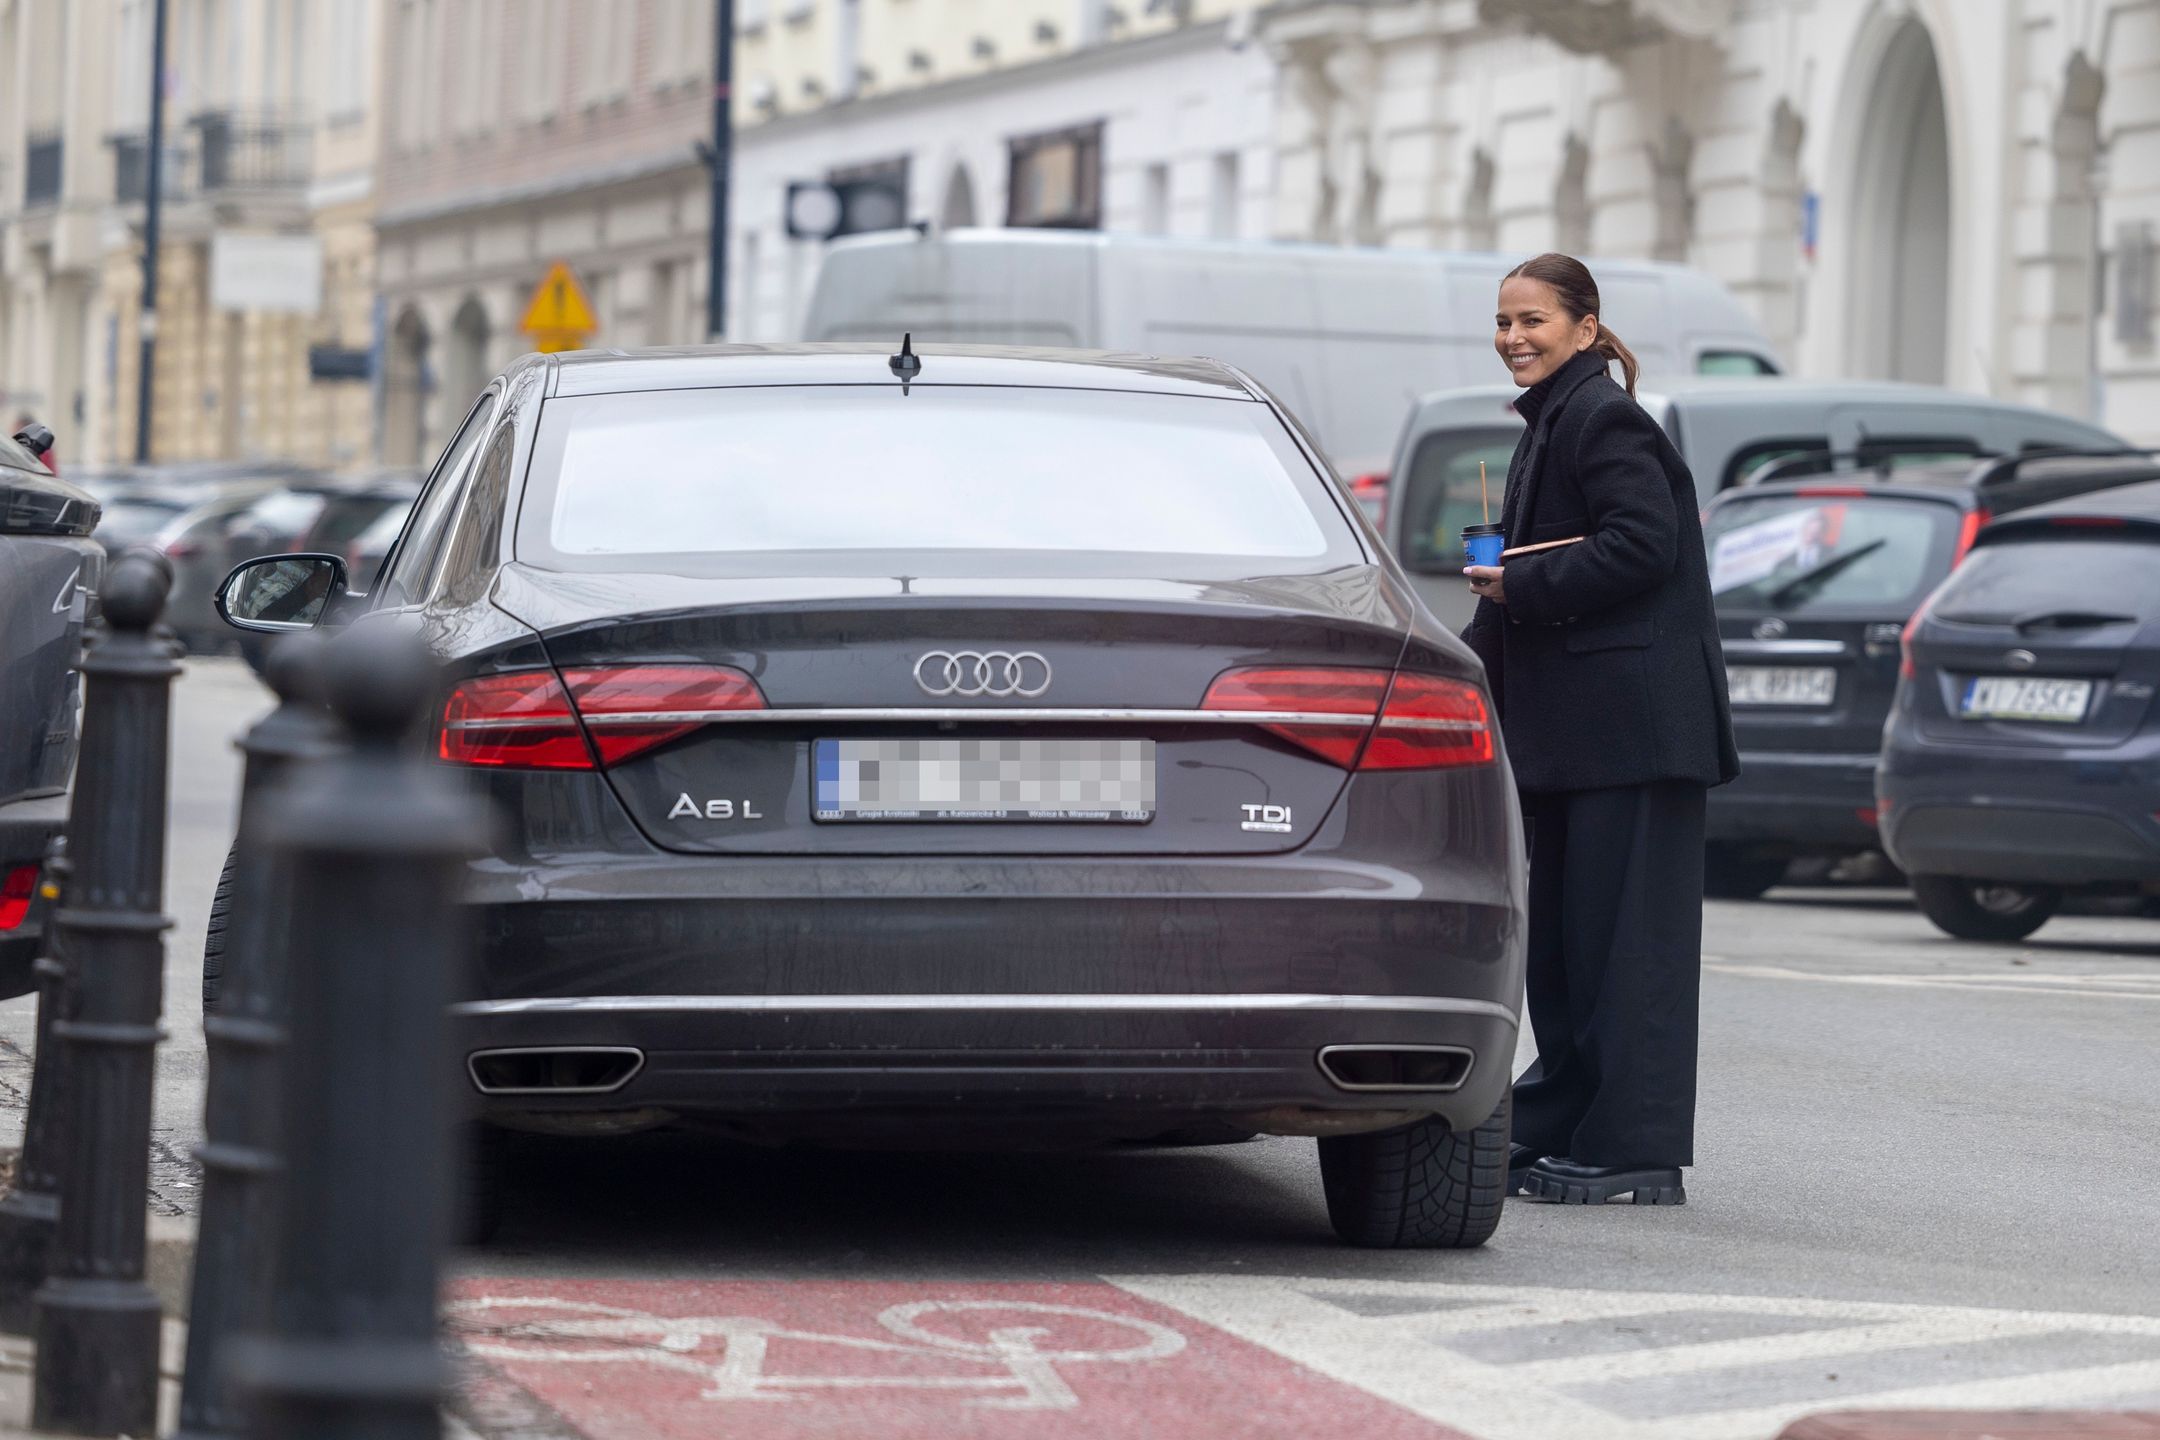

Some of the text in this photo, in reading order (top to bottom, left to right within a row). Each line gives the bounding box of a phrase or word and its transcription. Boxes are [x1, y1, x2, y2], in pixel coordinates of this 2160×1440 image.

[667, 792, 763, 819] A8 L
[1241, 804, 1292, 823] TDI
